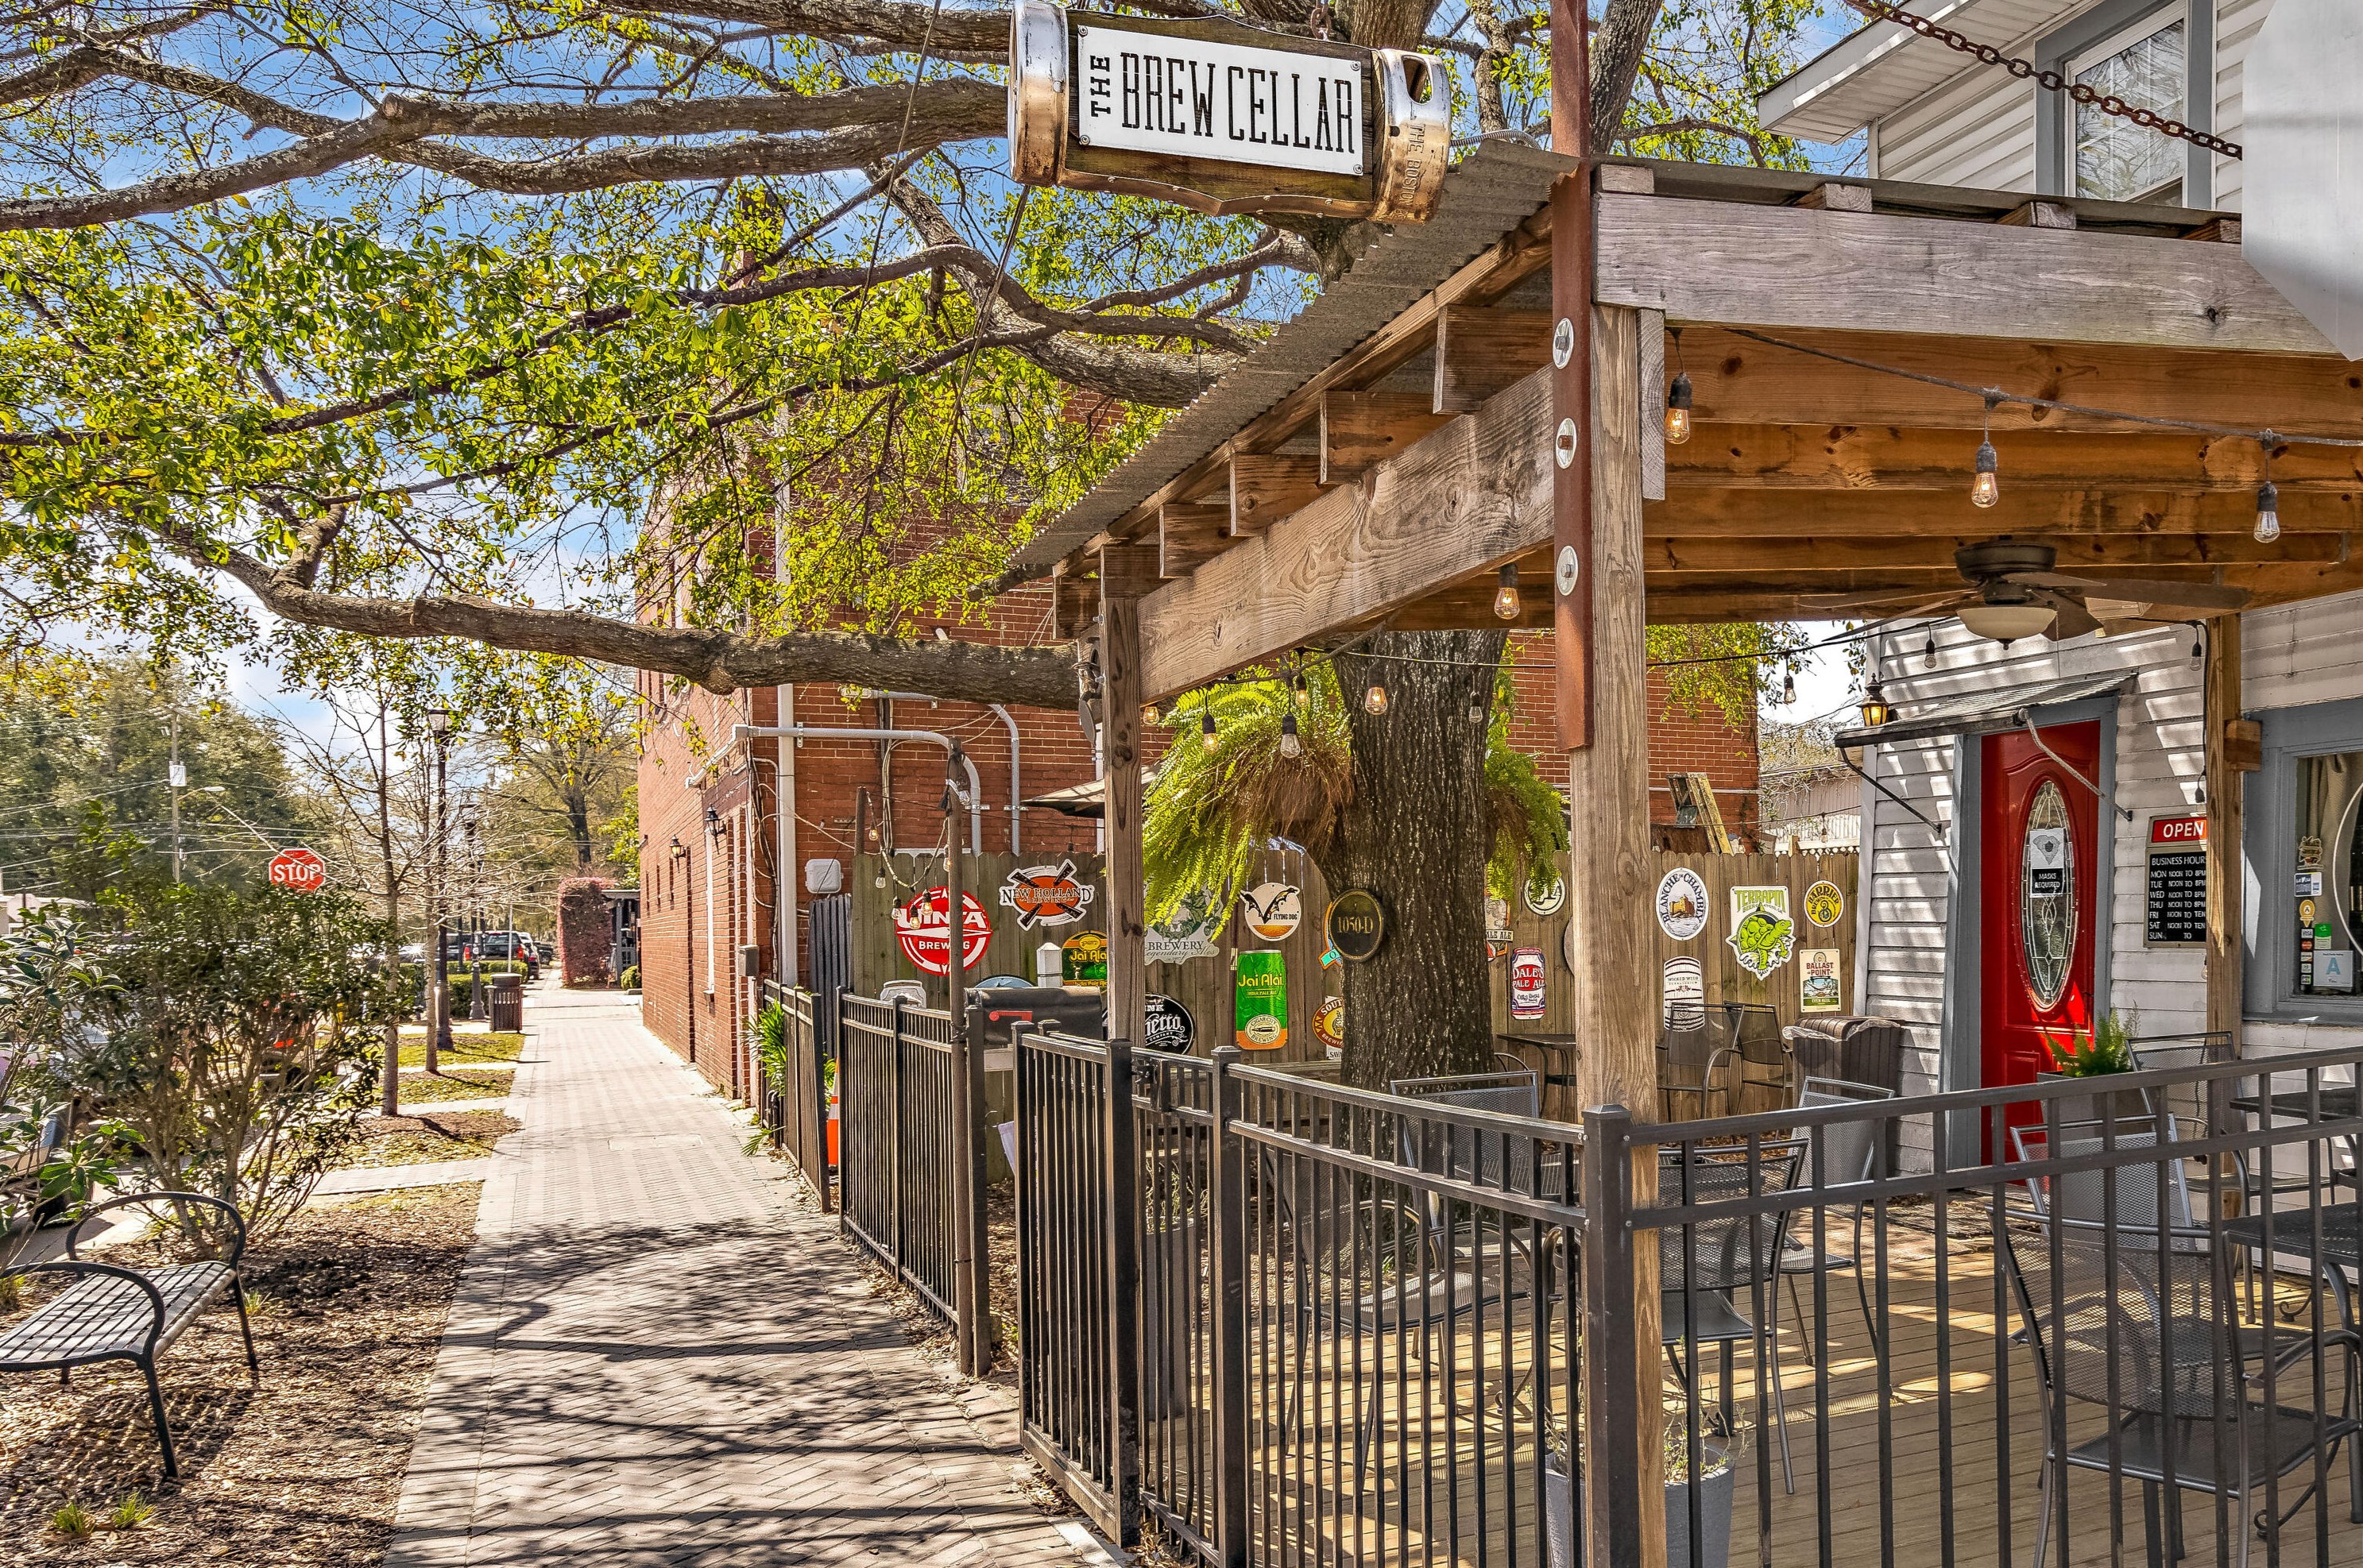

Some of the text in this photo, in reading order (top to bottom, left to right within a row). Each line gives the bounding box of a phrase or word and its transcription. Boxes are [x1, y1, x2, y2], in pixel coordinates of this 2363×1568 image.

[1090, 55, 1110, 118] THE
[1120, 52, 1354, 154] BREW CELLAR
[1407, 124, 1426, 153] THE
[1398, 159, 1422, 206] BOSTON
[2163, 821, 2204, 838] OPEN
[2152, 855, 2206, 866] BUSINESS HOUR
[273, 863, 321, 882] STOP
[1002, 887, 1092, 904] NEW HOLLAND
[1660, 873, 1680, 924] BLANCHE
[1683, 873, 1704, 923] CHAMBLY
[1734, 890, 1786, 913] TERRAPIN
[1808, 885, 1839, 904] BARRIER
[893, 908, 987, 929] UINA
[1499, 931, 1512, 940] ALE
[919, 940, 970, 950] BREWG
[1147, 940, 1205, 951] BREWERY
[1069, 949, 1107, 964] Jai Ala
[1144, 951, 1188, 964] egendary
[1512, 967, 1545, 980] DALE'S
[2326, 956, 2341, 975] A
[1238, 972, 1283, 987] Jai Alai
[1533, 979, 1545, 989] ALE
[1321, 999, 1343, 1016] SOUT
[1250, 1017, 1278, 1026] CIGAR CITY
[1149, 1032, 1173, 1041] COMPANY
[1251, 1033, 1278, 1043] BREWING
